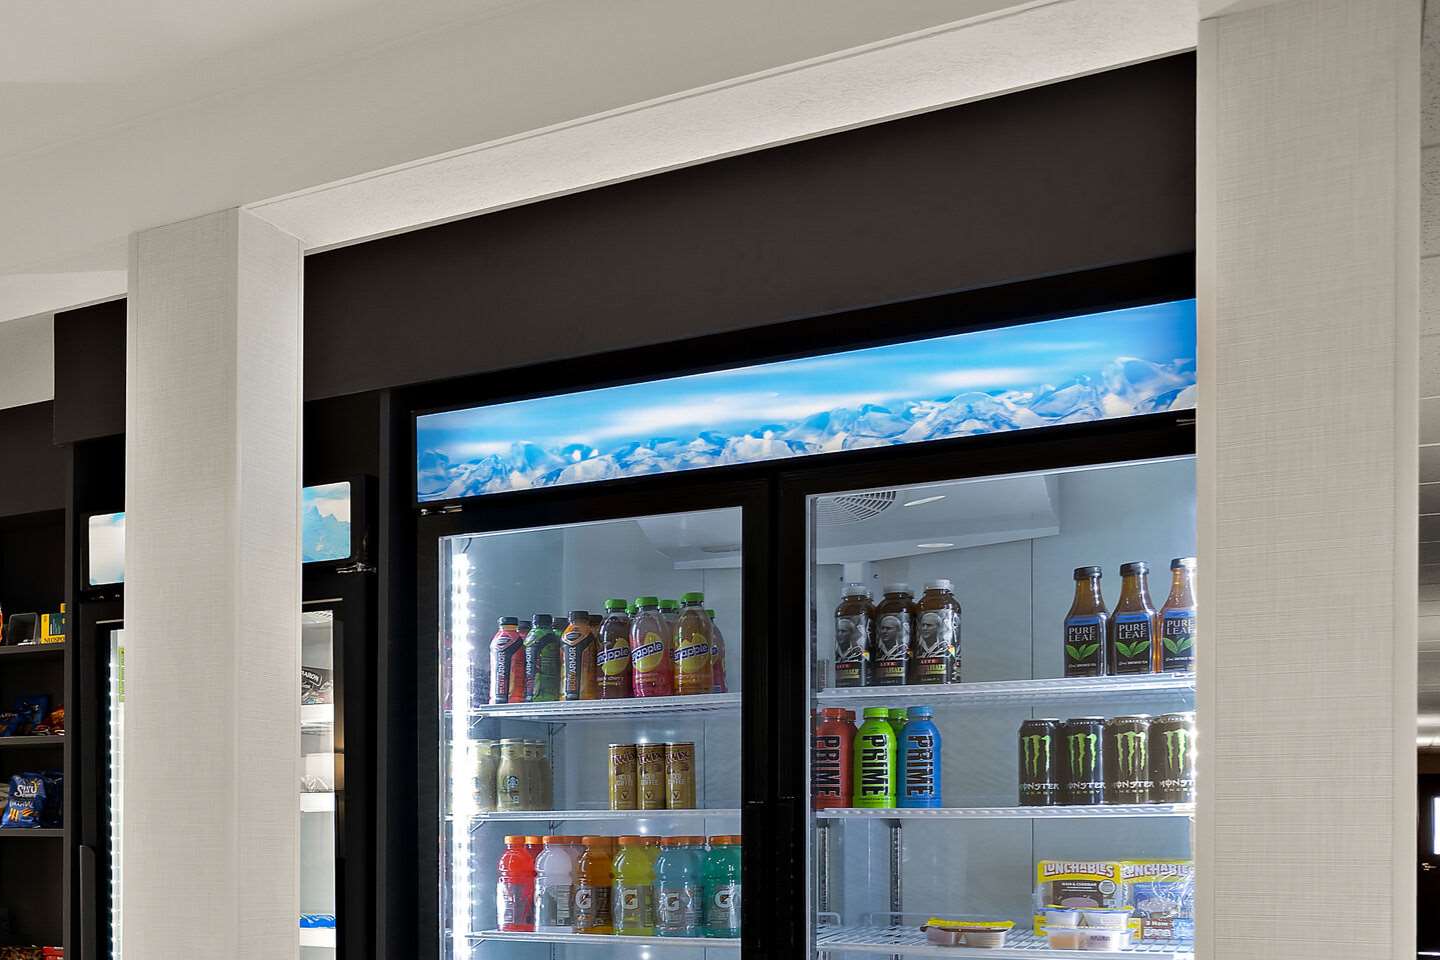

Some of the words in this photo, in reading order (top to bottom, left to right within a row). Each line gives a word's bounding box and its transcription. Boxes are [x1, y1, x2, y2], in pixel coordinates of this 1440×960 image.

[1068, 625, 1096, 635] PURE
[1119, 622, 1147, 633] PURE
[1068, 634, 1096, 642] LEAF
[1119, 631, 1147, 640] LEAF
[816, 735, 841, 797] PRIME
[862, 734, 888, 796] PRIME
[906, 735, 934, 797] PRIME
[1044, 863, 1115, 877] LUNCHABLES
